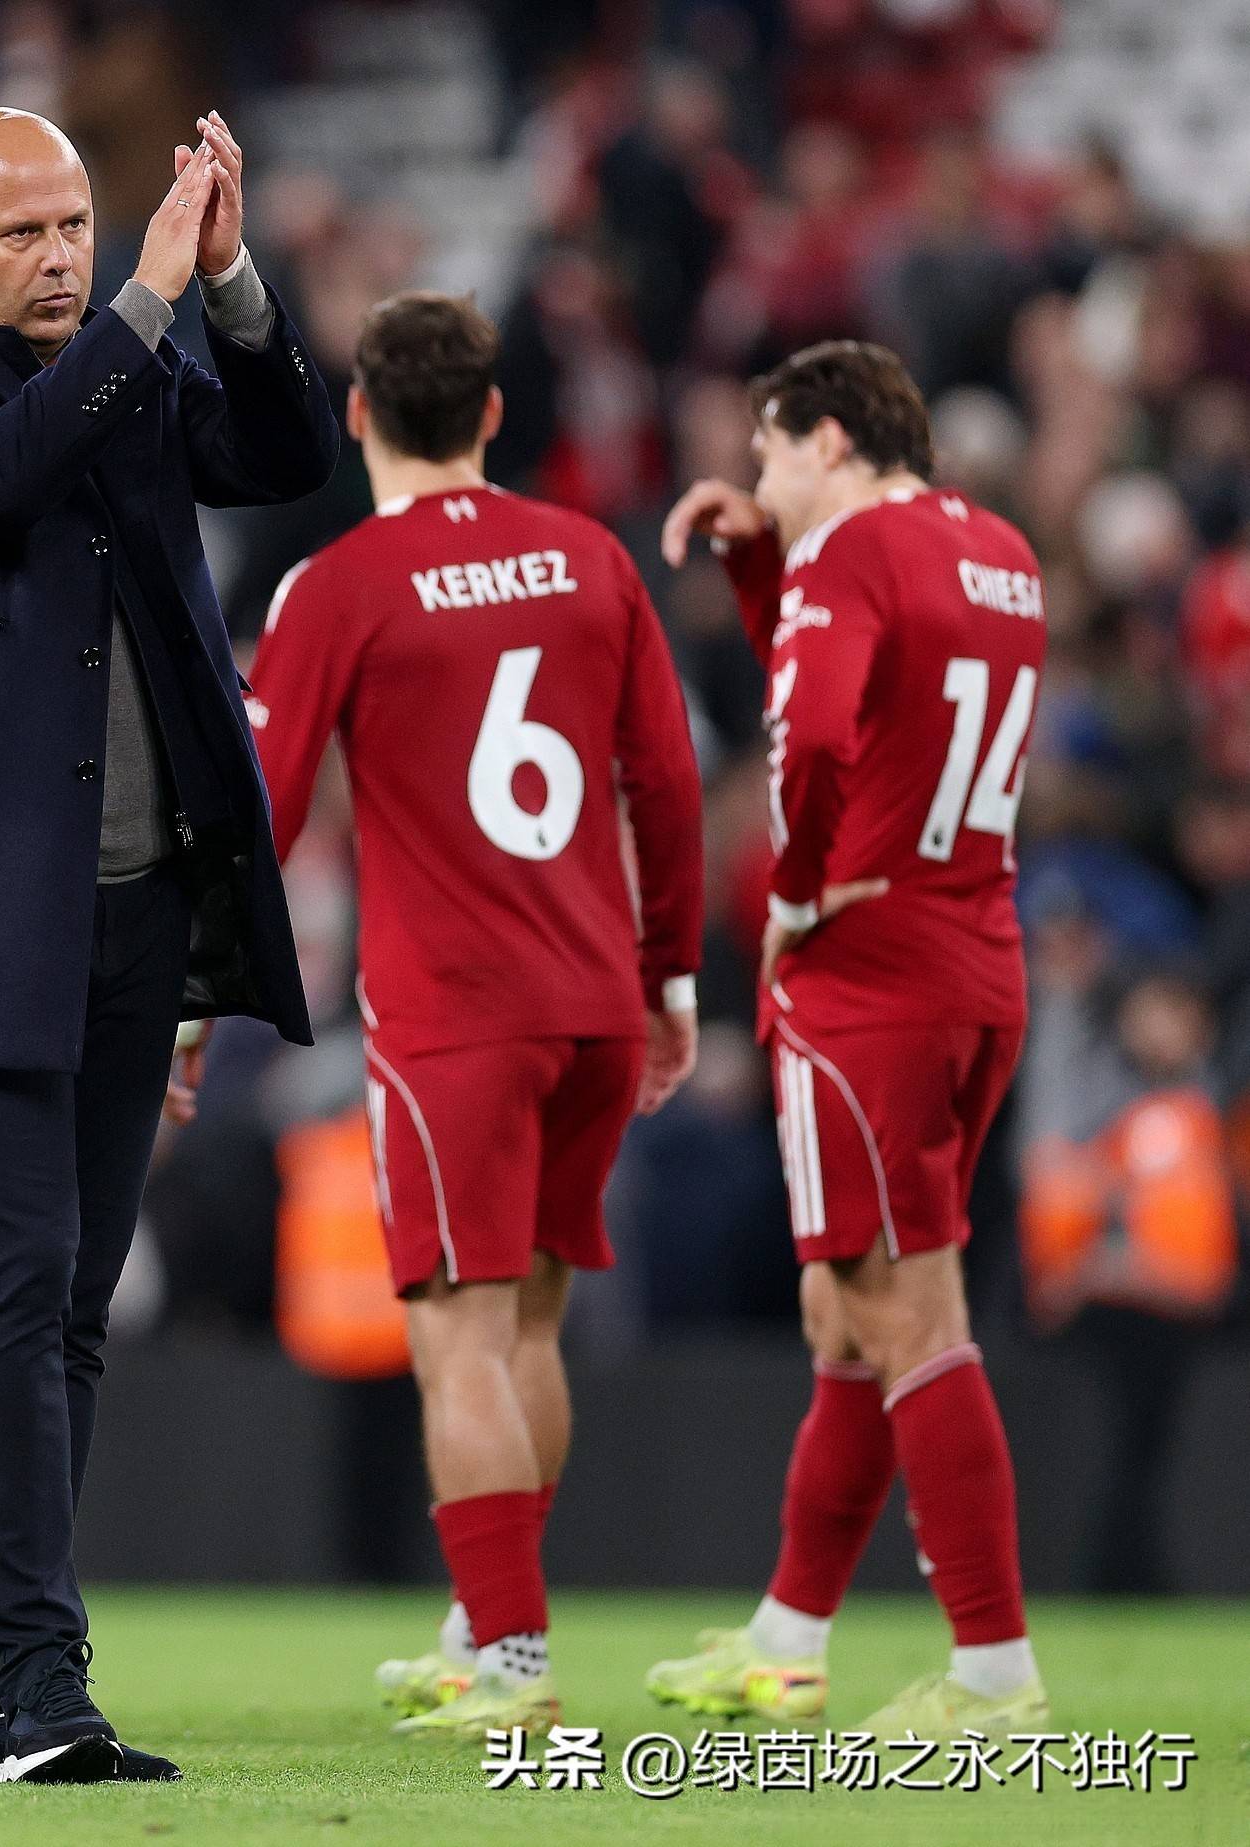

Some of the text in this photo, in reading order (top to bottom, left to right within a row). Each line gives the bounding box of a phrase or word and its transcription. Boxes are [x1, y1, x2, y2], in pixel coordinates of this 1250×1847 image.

[411, 550, 578, 613] KERKEZ
[466, 645, 586, 861] 6
[916, 656, 1037, 871] 14
